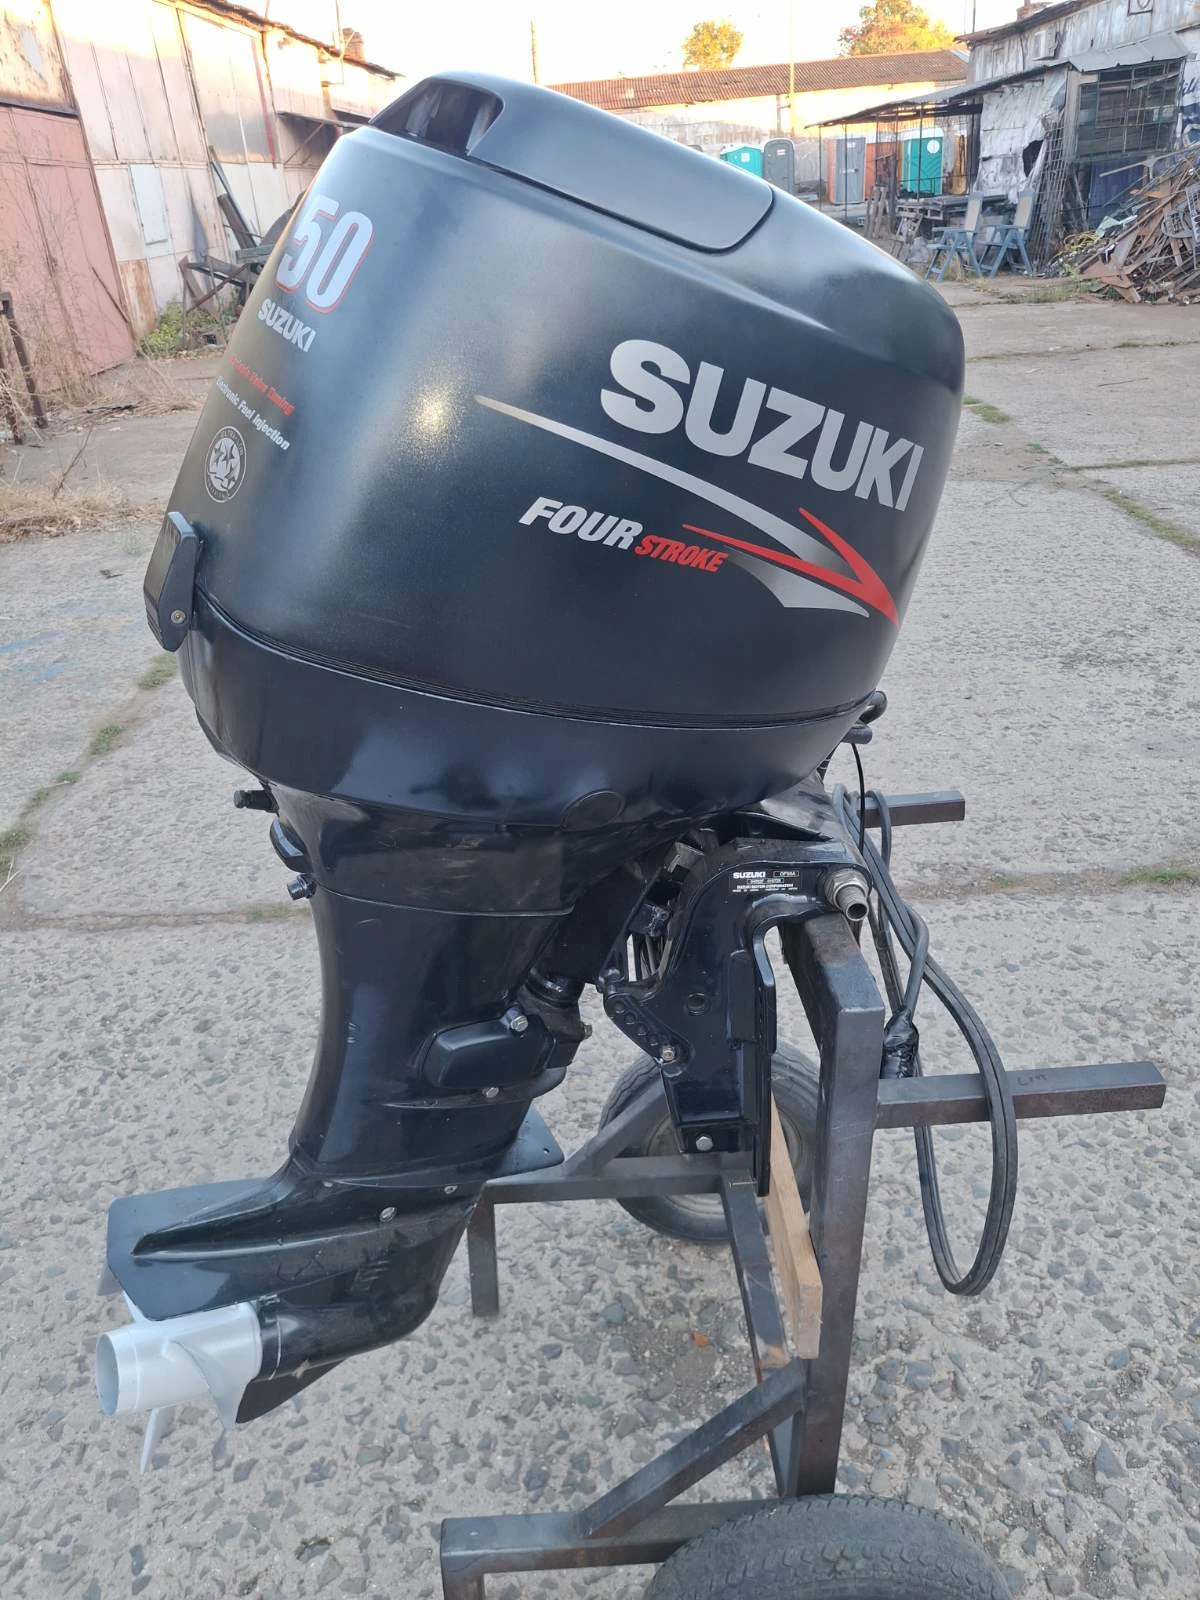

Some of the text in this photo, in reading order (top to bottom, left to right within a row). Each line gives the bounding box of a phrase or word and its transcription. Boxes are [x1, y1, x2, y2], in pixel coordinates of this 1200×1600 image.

[274, 194, 376, 314] 50
[258, 298, 316, 352] SUZUKI
[238, 399, 256, 421] Fuel
[252, 413, 291, 451] Injection
[600, 338, 925, 512] SUZUKI
[518, 496, 730, 573] FOUR STROKE
[733, 871, 766, 879] SUZUKI
